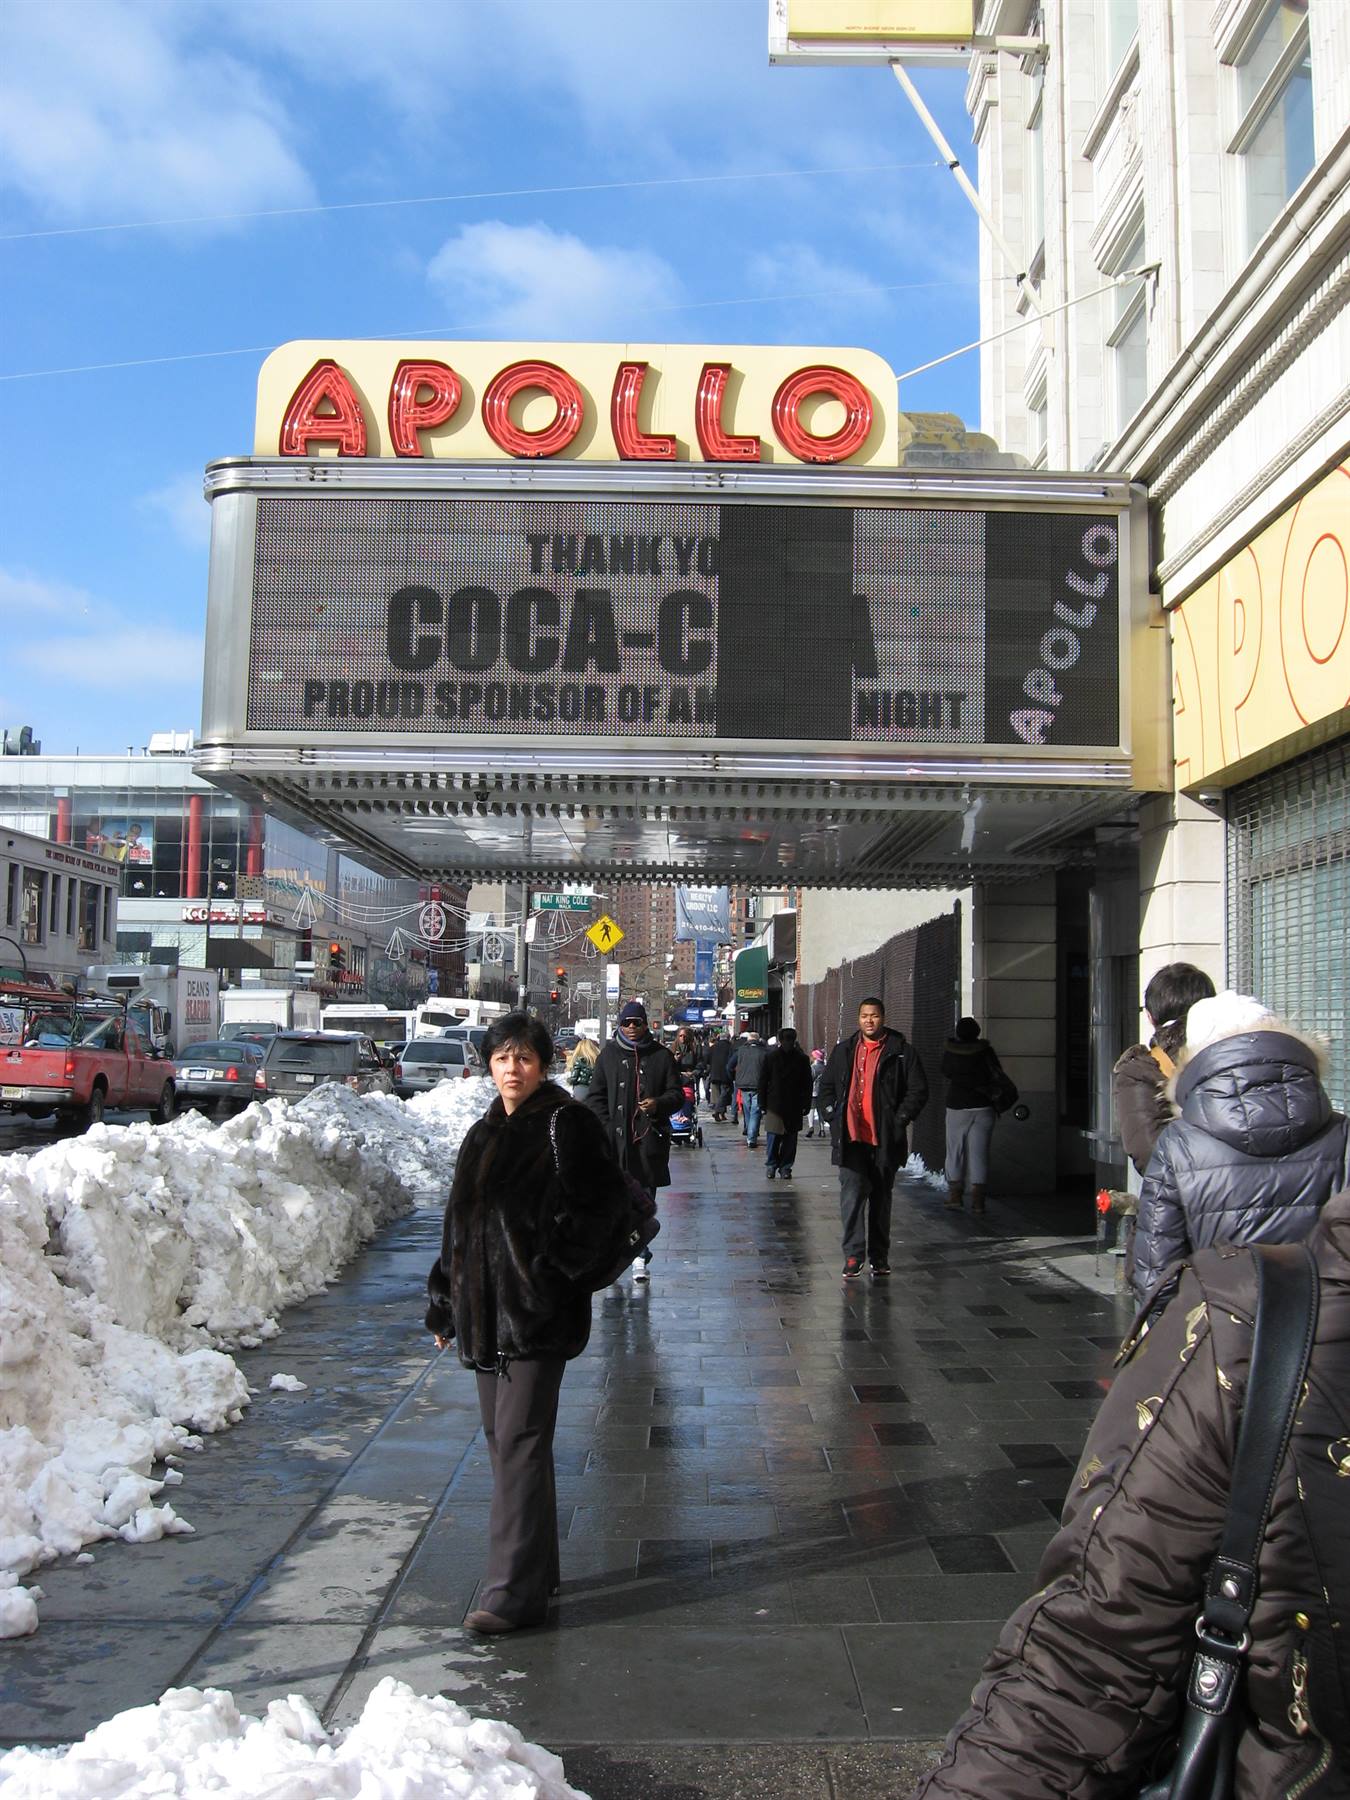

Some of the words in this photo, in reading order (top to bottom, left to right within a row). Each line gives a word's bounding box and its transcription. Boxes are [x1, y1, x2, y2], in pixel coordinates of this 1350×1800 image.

[279, 358, 874, 465] APOLLO
[526, 534, 663, 576] THANK
[1009, 524, 1118, 745] APOLLO
[303, 680, 424, 718] PROUD
[434, 682, 605, 721] SPONSOR
[620, 685, 661, 721] OF
[857, 690, 967, 728] NIGHT
[541, 894, 553, 903] NAT
[555, 895, 570, 904] KING
[572, 896, 589, 905] COLE
